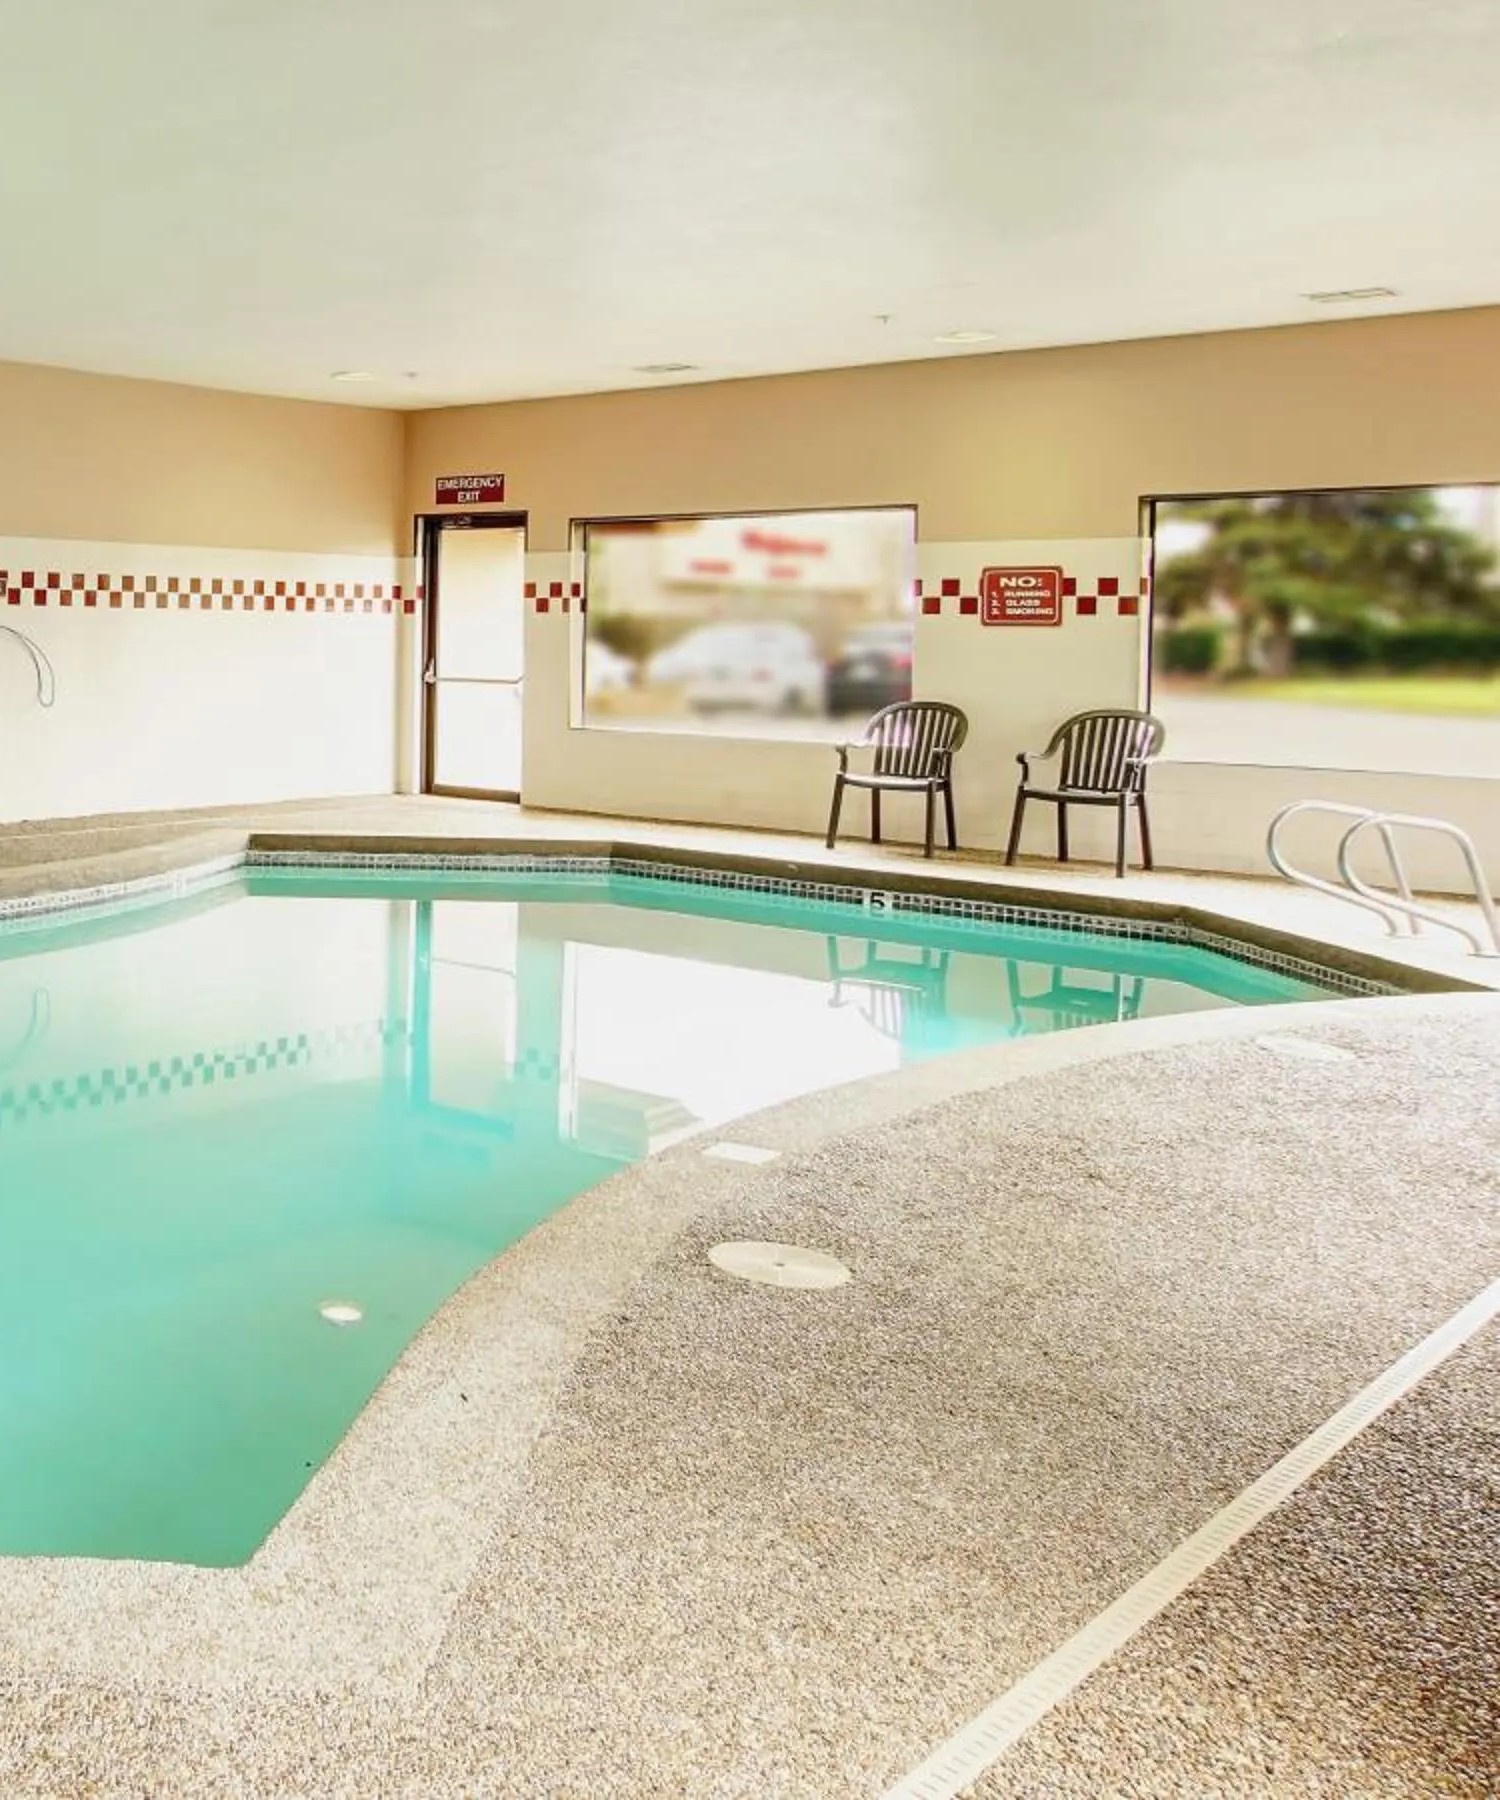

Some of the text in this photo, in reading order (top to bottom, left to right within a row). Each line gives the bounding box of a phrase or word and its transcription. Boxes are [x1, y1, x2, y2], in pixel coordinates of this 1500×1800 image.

[438, 476, 502, 490] EMERGENCY
[458, 491, 480, 502] EXIT
[1005, 599, 1041, 607] GLASS
[870, 891, 885, 909] 5
